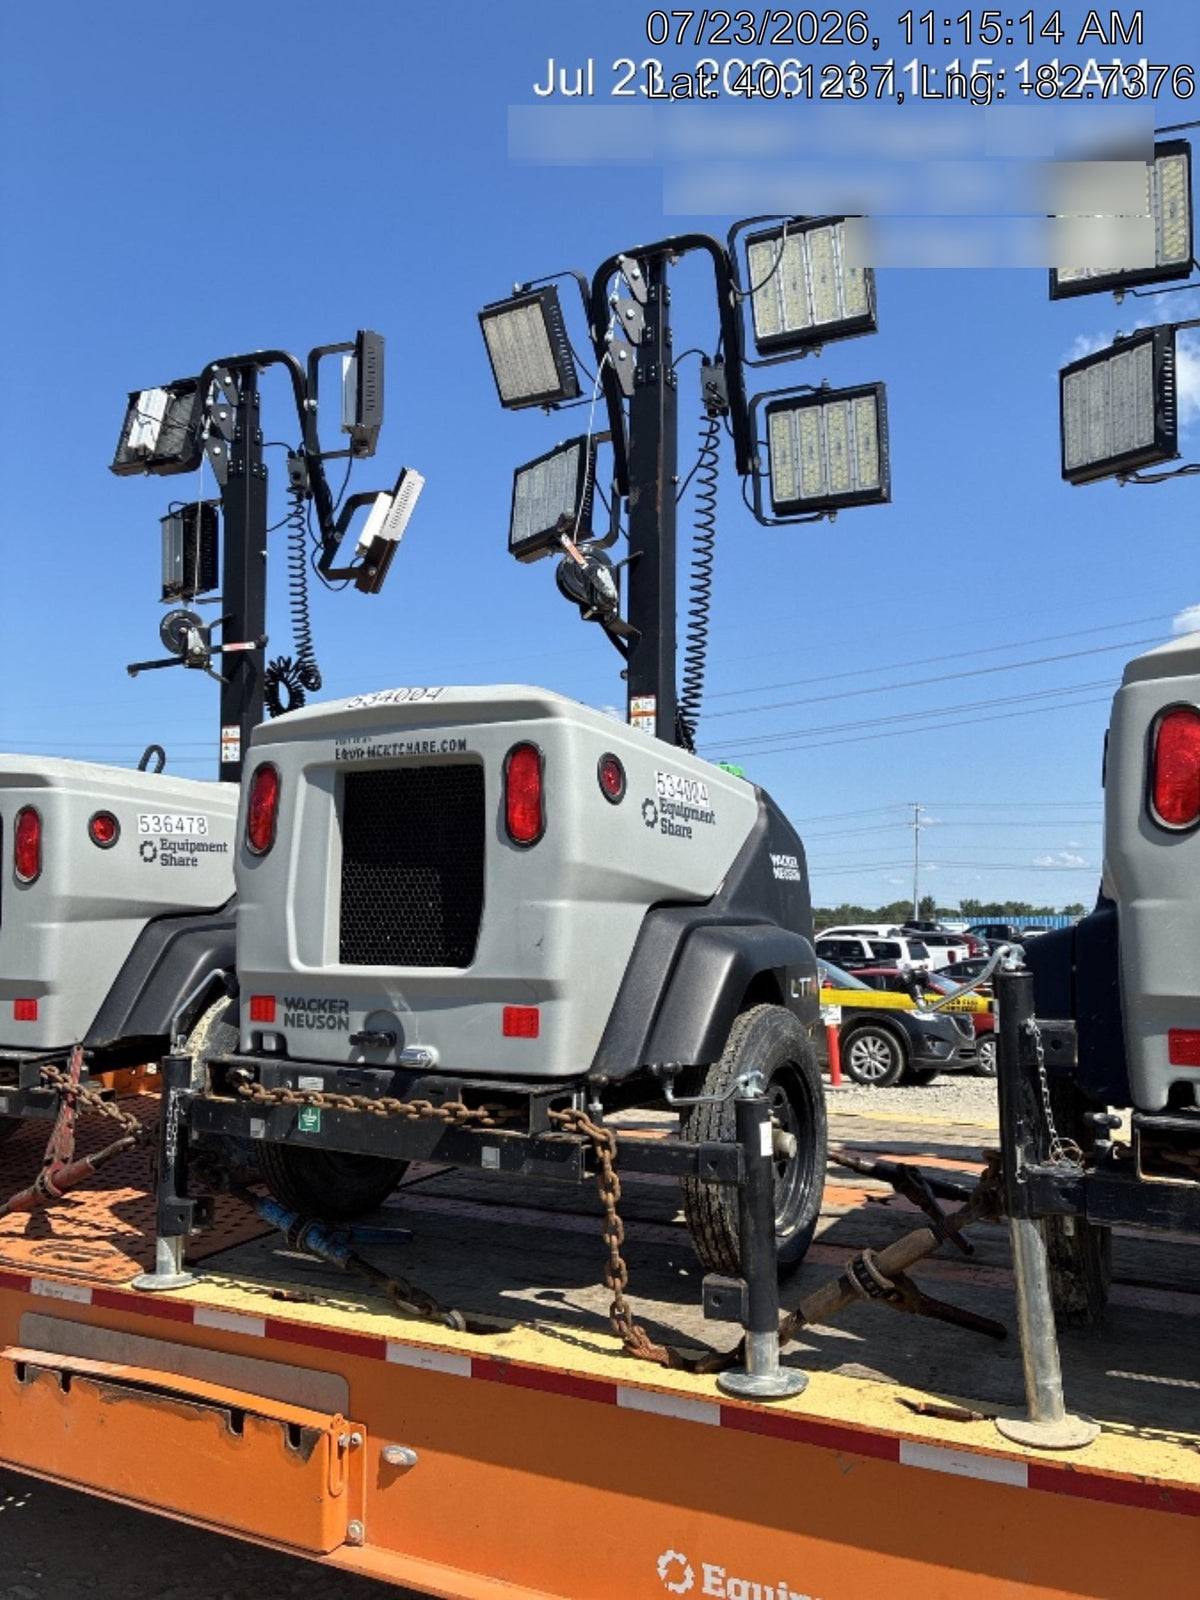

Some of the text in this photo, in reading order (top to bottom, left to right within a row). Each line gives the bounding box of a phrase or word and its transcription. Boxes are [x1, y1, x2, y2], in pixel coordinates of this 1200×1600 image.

[659, 796, 716, 825] Equipment
[139, 815, 207, 834] 536478
[660, 817, 692, 839] Share
[160, 838, 228, 854] Equipment
[160, 854, 198, 867] Share
[284, 996, 349, 1014] WACKER
[284, 1012, 350, 1031] NEUSON
